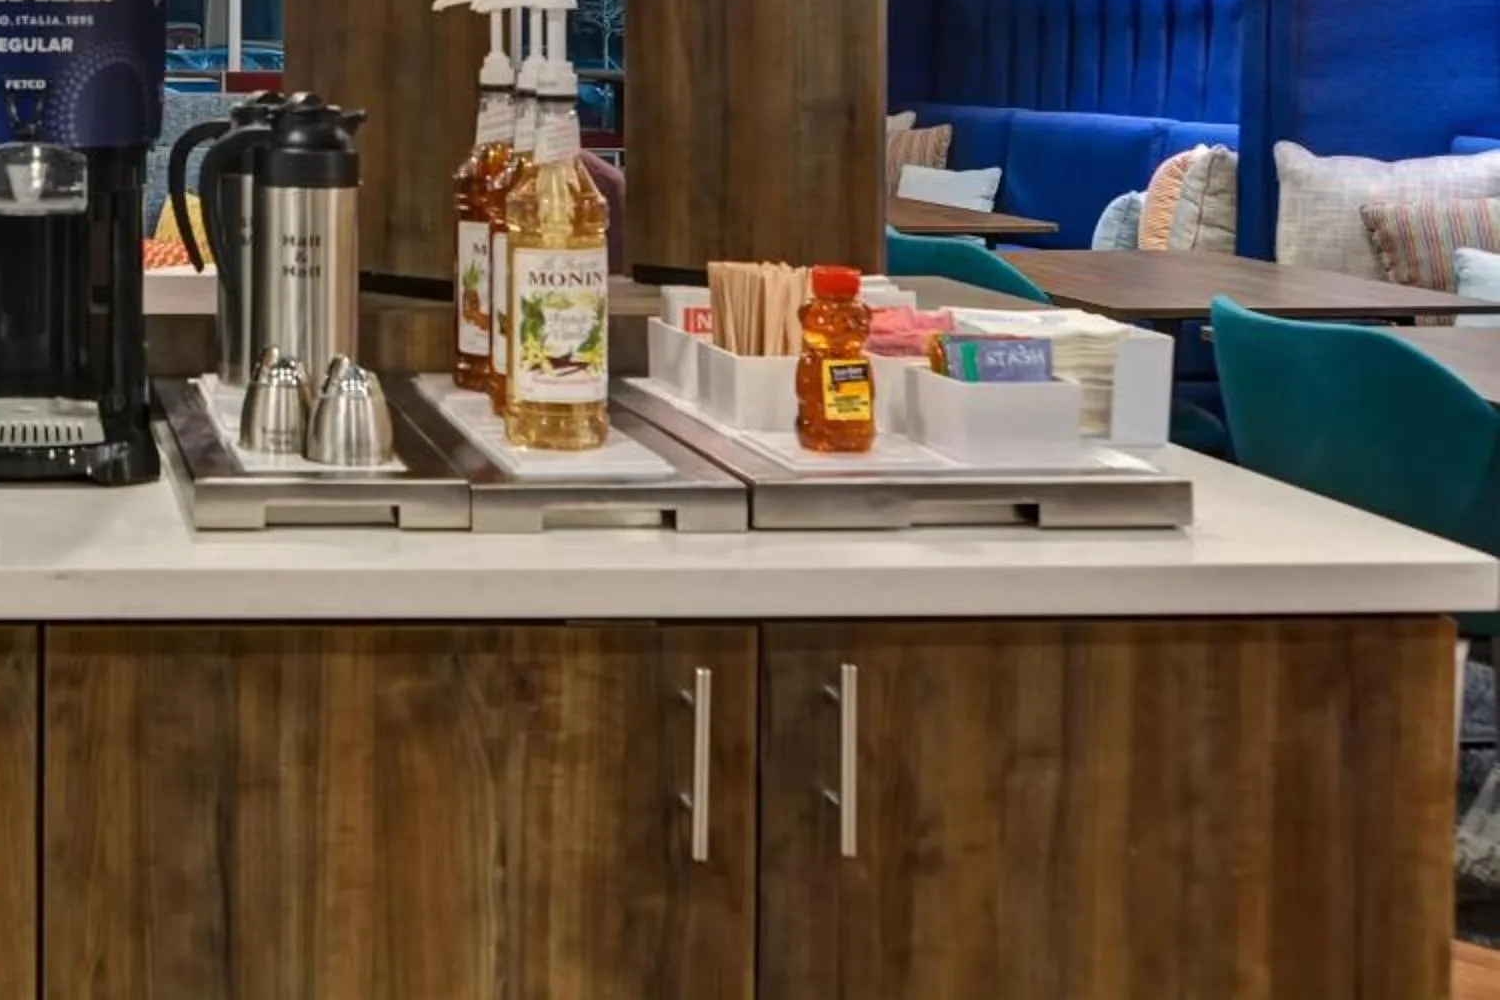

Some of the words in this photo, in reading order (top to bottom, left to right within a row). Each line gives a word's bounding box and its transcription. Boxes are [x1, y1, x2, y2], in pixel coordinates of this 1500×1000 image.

[4, 79, 47, 90] FETCO
[528, 270, 604, 289] MONIN
[986, 343, 1046, 367] STASH
